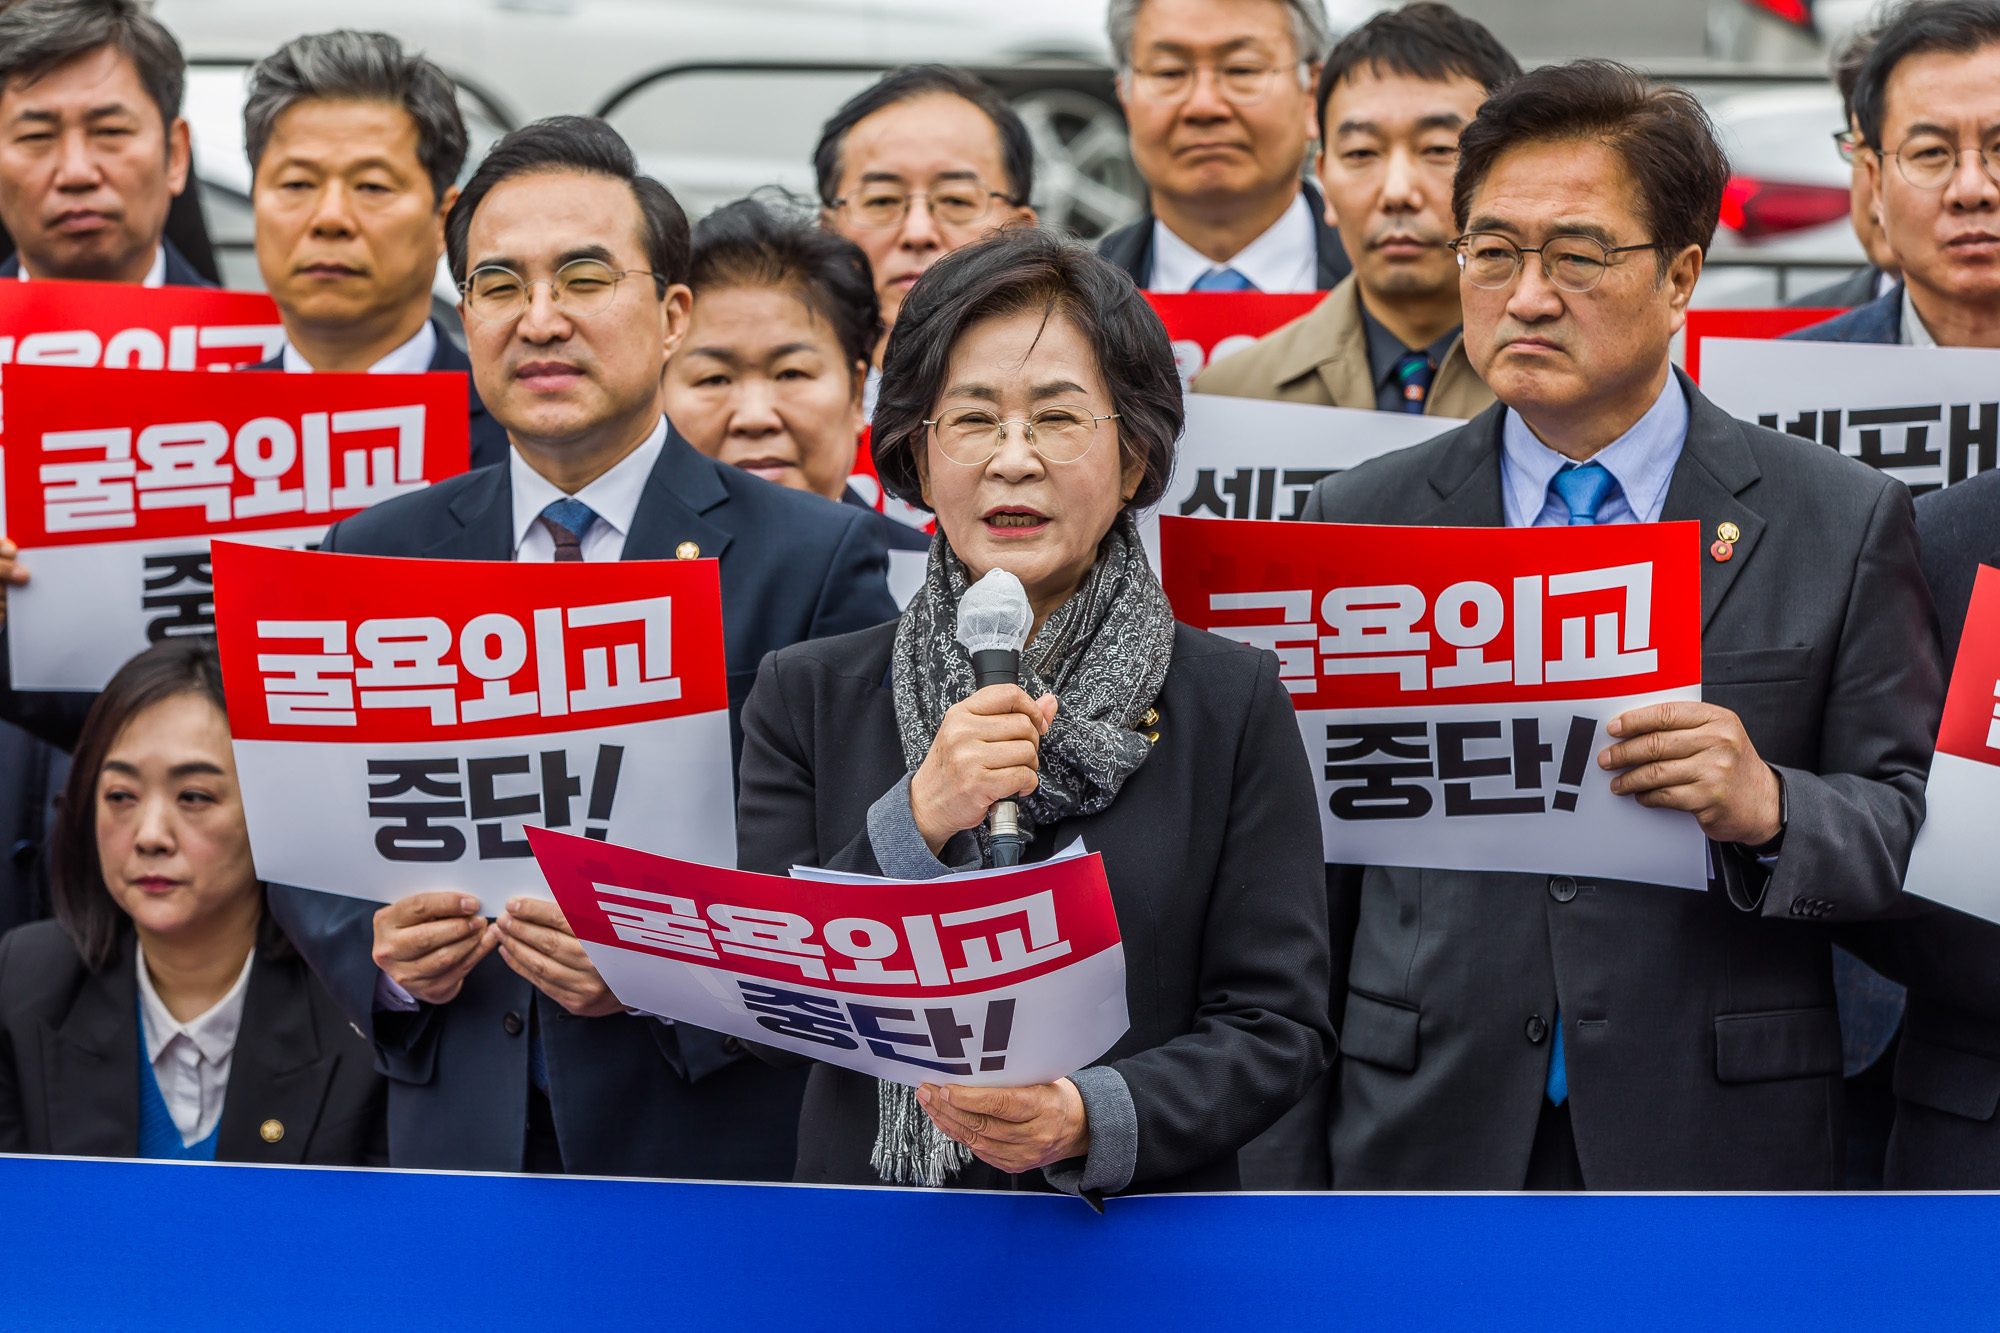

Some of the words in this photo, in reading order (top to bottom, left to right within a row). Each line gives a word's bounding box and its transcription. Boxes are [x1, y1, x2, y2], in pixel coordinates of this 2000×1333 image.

[39, 404, 432, 533] 굴욕외교
[256, 595, 682, 726] 굴욕외교
[366, 743, 625, 863] 중단!
[1324, 714, 1598, 822] 중단!
[591, 881, 1073, 987] 굴욕외교
[735, 979, 1017, 1076] 중단!
